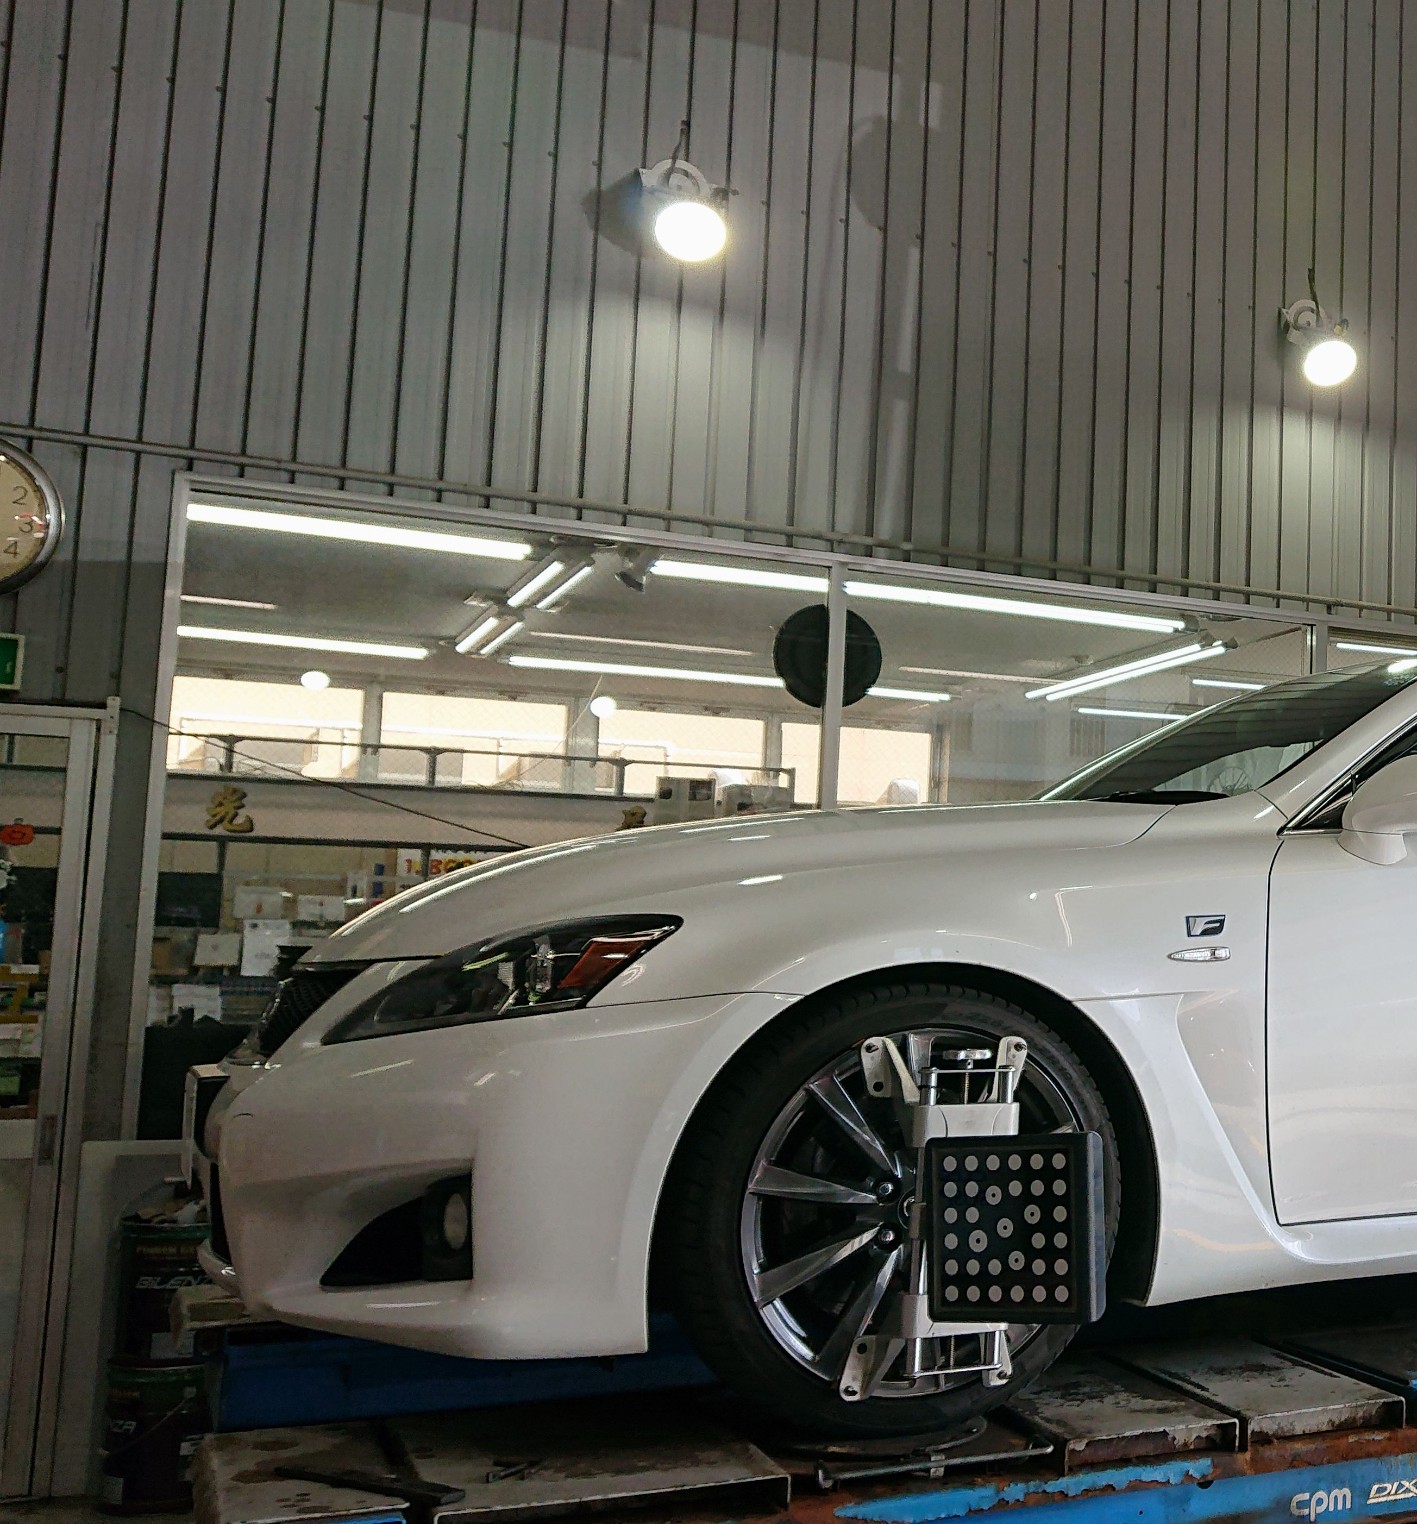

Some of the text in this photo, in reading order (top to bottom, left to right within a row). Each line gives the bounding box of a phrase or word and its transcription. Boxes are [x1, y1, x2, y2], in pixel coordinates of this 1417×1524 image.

[12, 485, 28, 505] 2
[18, 515, 34, 534] 3
[2, 540, 20, 558] 4
[1291, 1486, 1352, 1522] cpm
